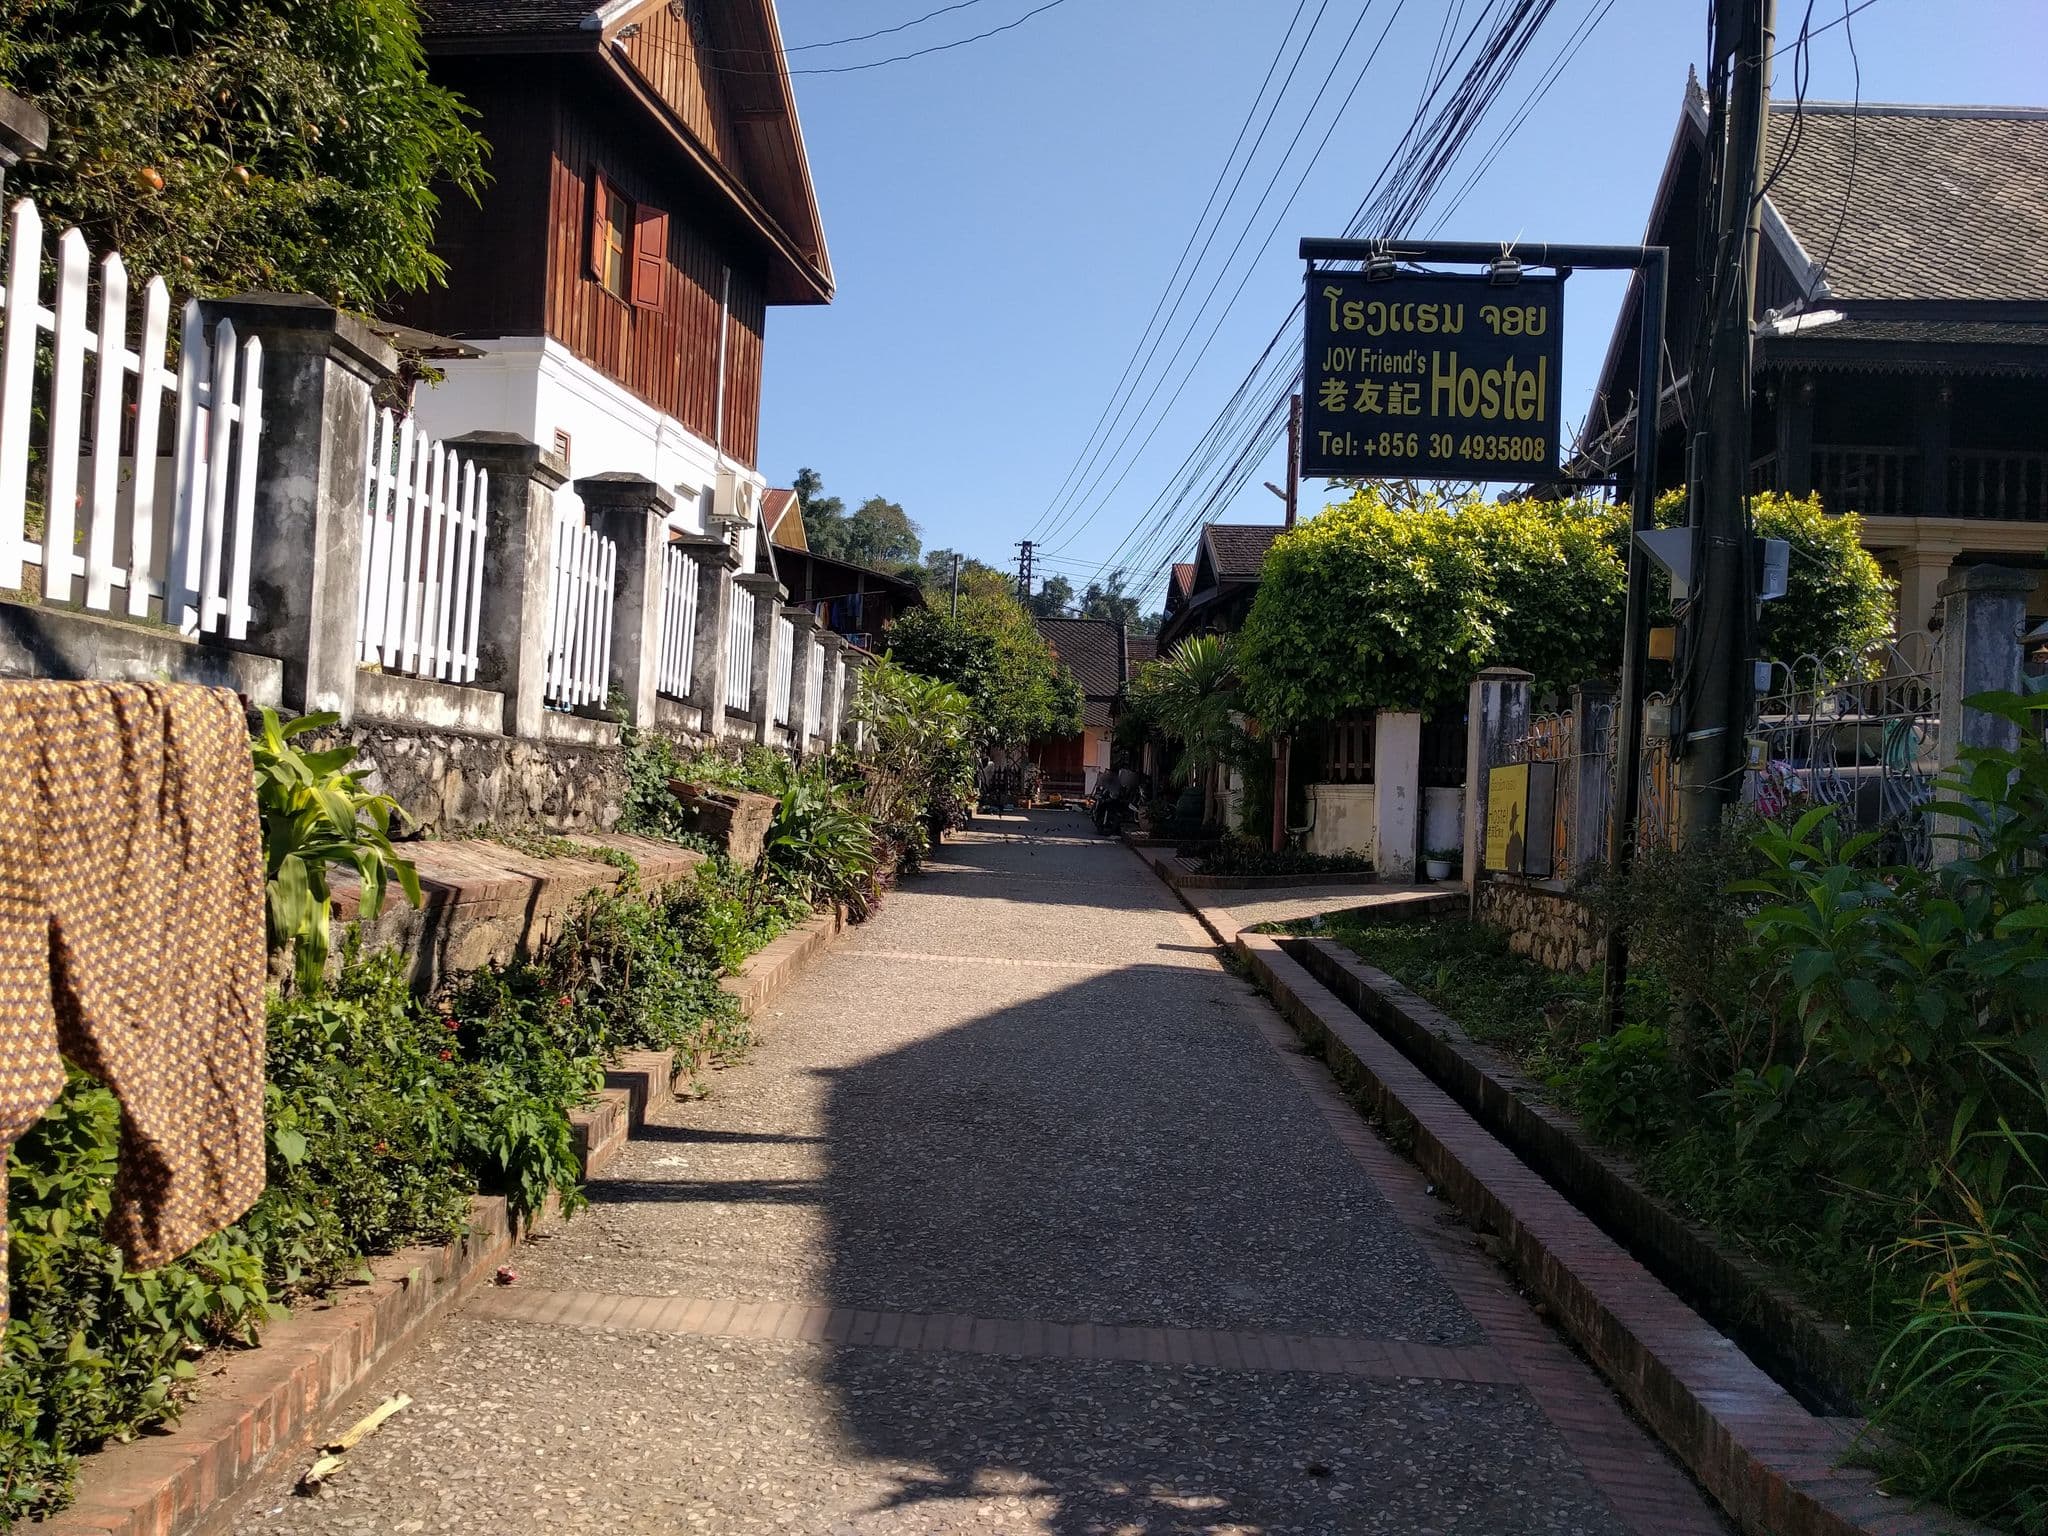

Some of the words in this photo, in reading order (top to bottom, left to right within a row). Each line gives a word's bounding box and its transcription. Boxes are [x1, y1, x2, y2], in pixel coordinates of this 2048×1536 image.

[1479, 304, 1548, 337] ຈອຍ
[1322, 347, 1357, 372] JOY
[1360, 348, 1427, 374] Friend's
[1318, 377, 1422, 416] 老友記
[1430, 350, 1548, 422] Hostel
[1318, 431, 1358, 456] Tel:
[1363, 432, 1419, 458] +856
[1429, 433, 1454, 459] 30
[1458, 434, 1546, 462] 4935808
